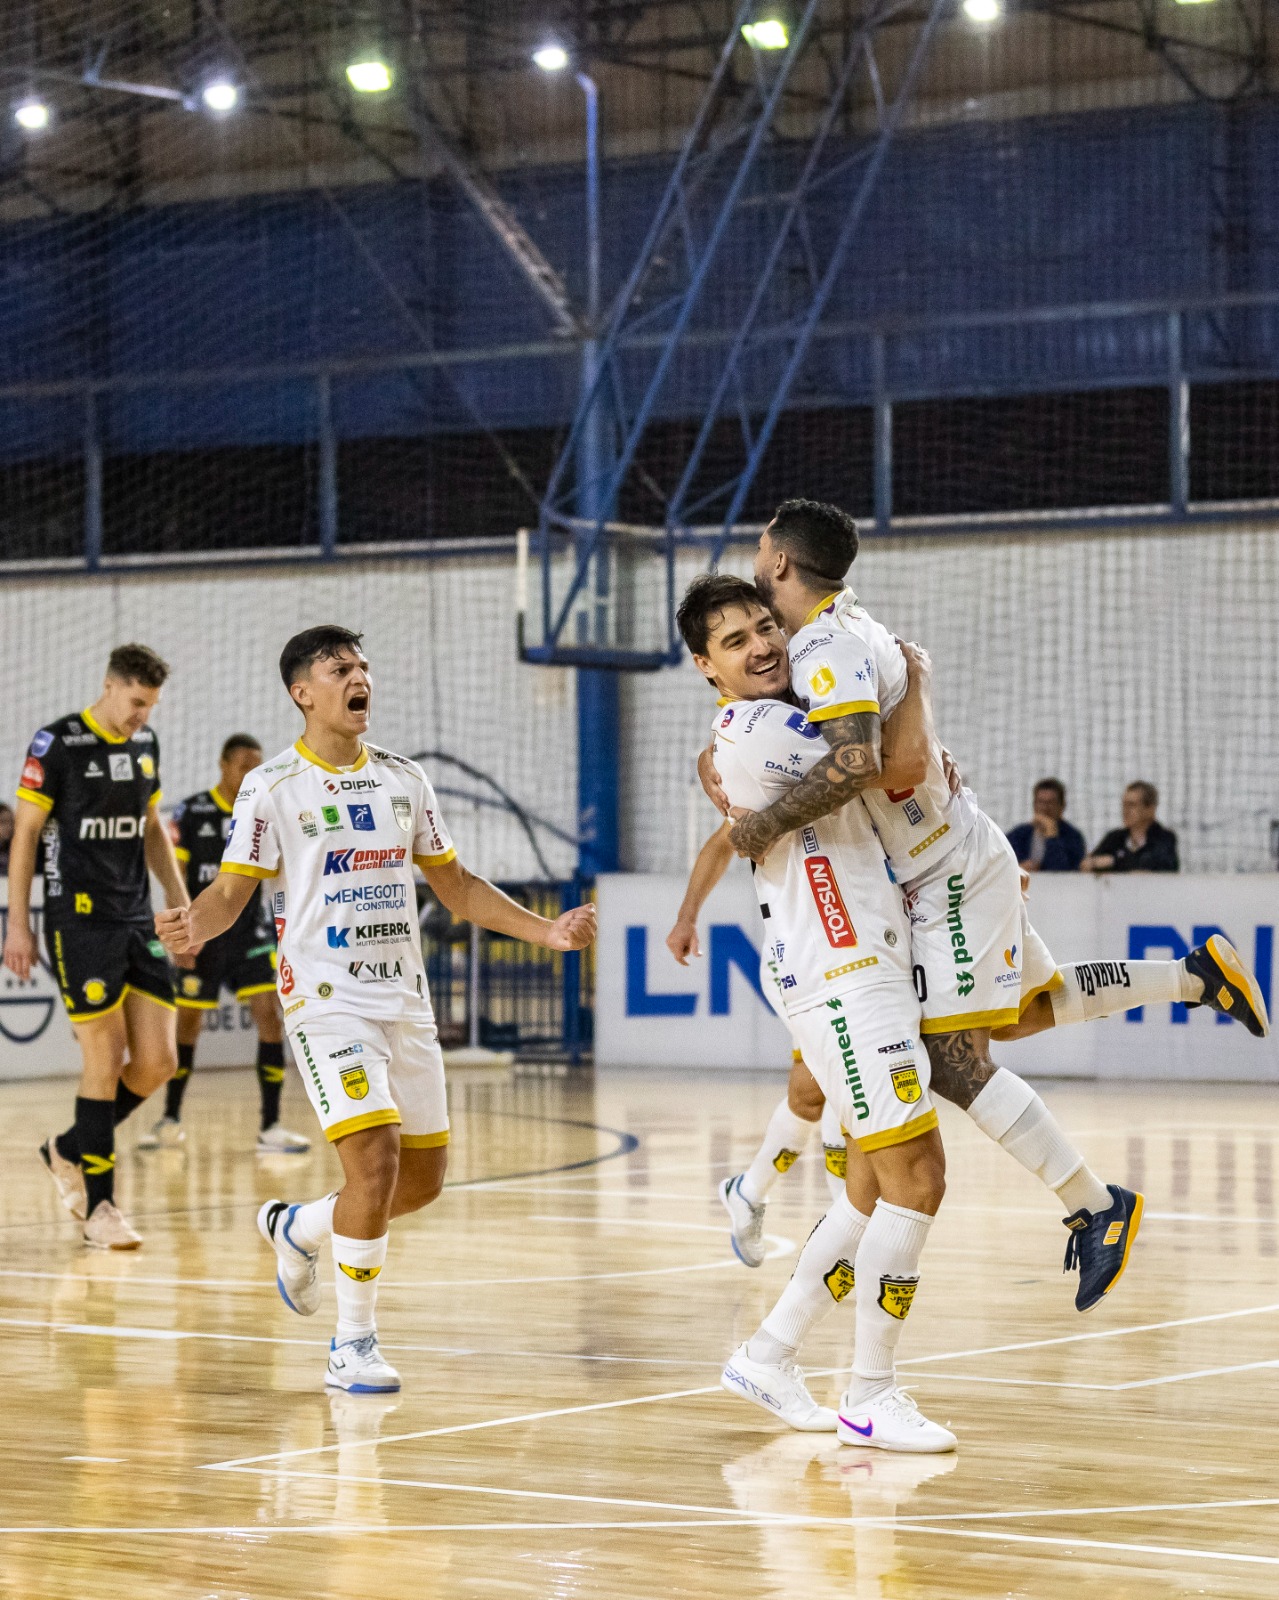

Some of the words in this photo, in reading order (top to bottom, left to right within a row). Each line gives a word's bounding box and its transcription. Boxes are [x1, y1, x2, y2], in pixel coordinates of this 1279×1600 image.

[340, 779, 383, 791] DIPIL
[249, 817, 265, 862] Zuttel
[325, 884, 407, 906] MENEGOTTI
[810, 864, 849, 943] TOPSUN
[947, 873, 973, 964] Unimed
[355, 922, 411, 939] KIFERRO
[296, 1031, 330, 1114] Unimed
[831, 1016, 870, 1120] Unimed
